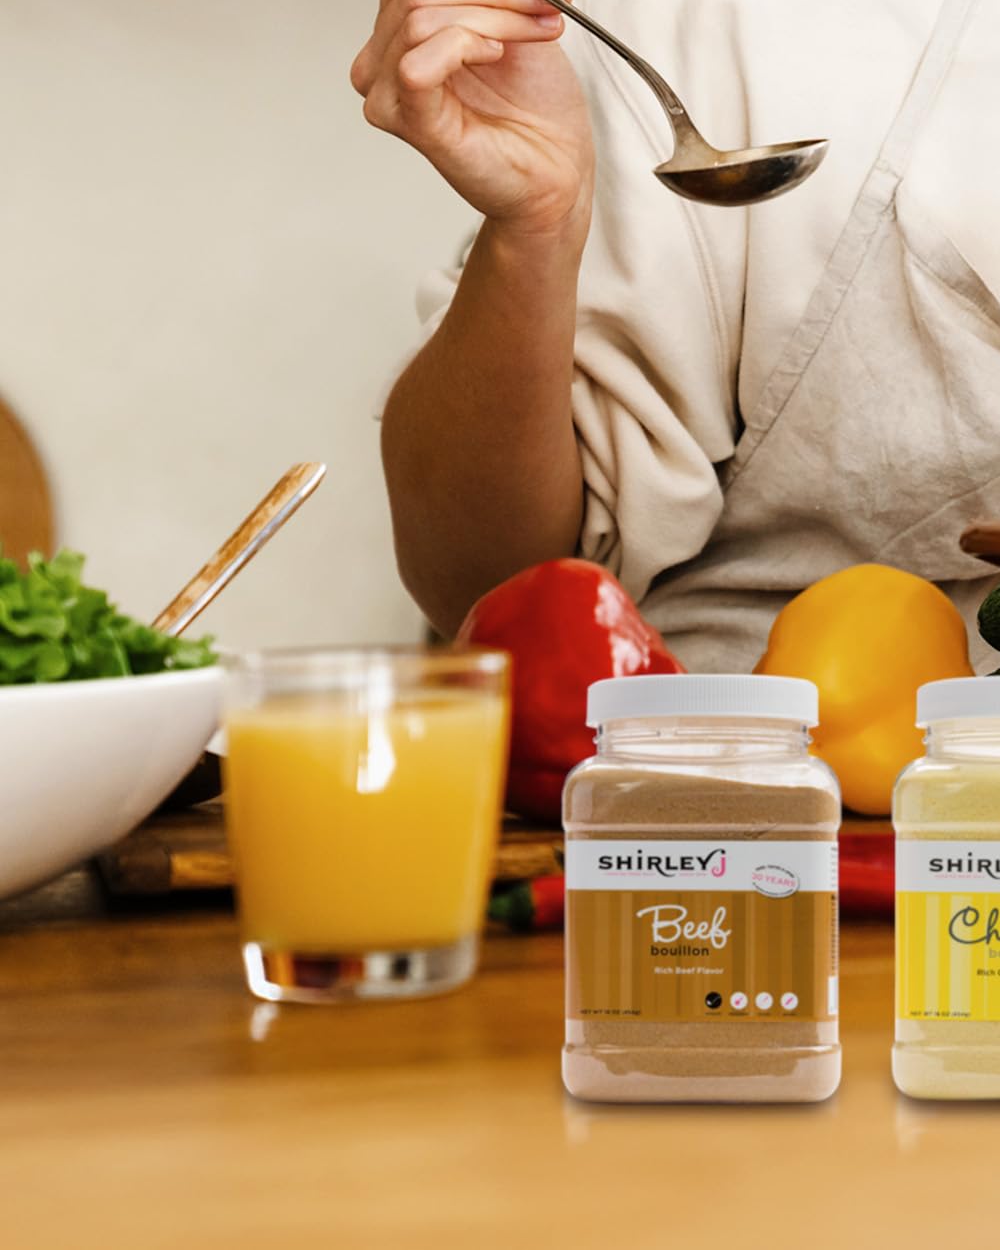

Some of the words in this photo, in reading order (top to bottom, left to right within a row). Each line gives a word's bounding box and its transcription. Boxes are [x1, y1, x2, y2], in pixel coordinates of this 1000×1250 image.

[765, 875, 796, 888] YEARS
[636, 904, 732, 949] Beef
[650, 945, 709, 956] bouillon
[654, 965, 673, 975] Rich
[675, 965, 695, 975] Beef
[696, 965, 724, 975] Flavor
[976, 968, 995, 977] Rich
